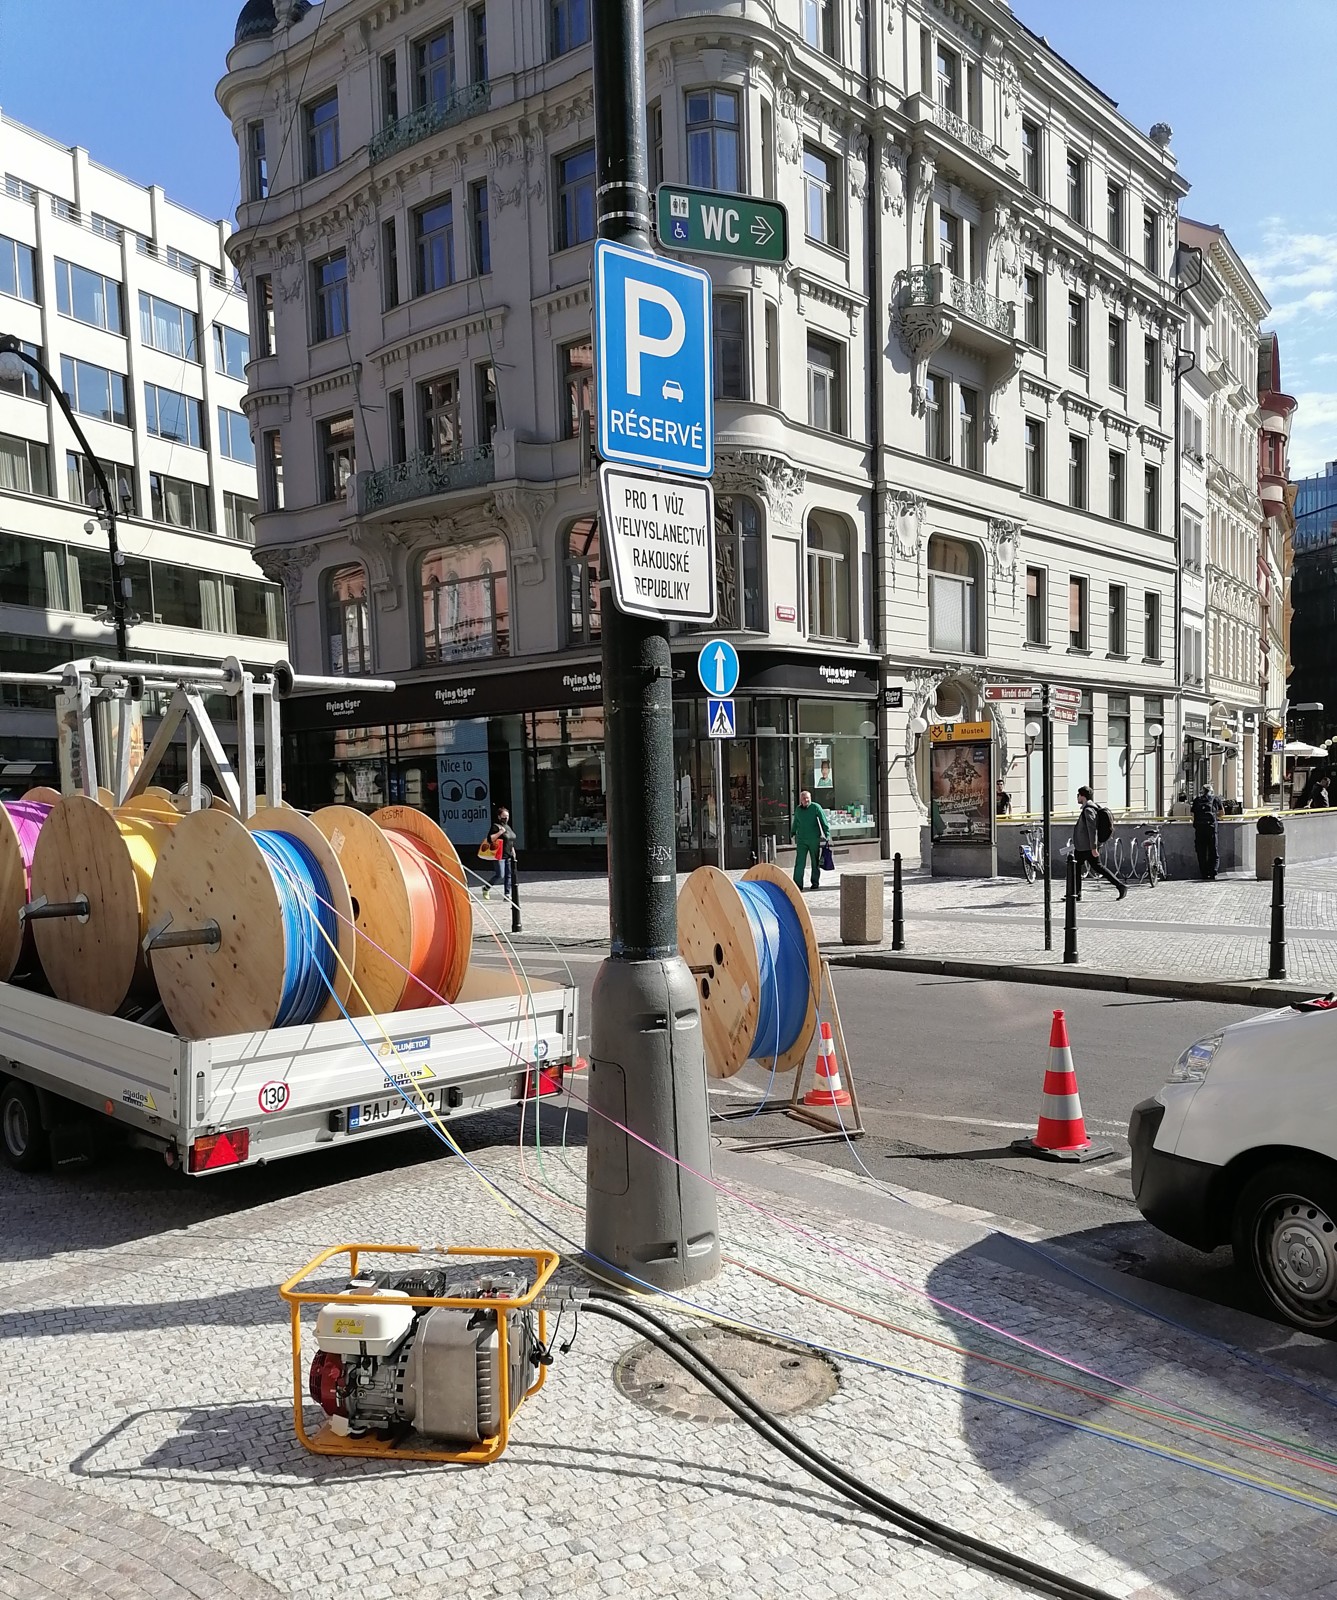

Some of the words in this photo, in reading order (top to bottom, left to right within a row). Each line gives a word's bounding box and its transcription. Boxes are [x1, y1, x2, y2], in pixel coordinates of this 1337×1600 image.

[701, 205, 740, 243] WC
[625, 277, 686, 396] P
[611, 409, 704, 449] RÉSERVÉ
[625, 489, 647, 510] PRO
[652, 494, 659, 511] 1
[664, 492, 685, 516] VŮZ
[615, 516, 706, 547] VELVYSLANECTVÍ
[633, 548, 690, 573] RAKOUSKÉ
[634, 577, 691, 600] REPUBLIKY
[563, 674, 588, 687] flying
[588, 672, 602, 685] tig
[819, 665, 839, 678] flying
[840, 666, 857, 679] tiger
[435, 689, 456, 701] flying
[457, 687, 476, 698] tiger
[326, 701, 344, 712] flying
[344, 699, 361, 710] tiger
[946, 733, 953, 741] B
[440, 759, 461, 773] Nice
[463, 760, 473, 772] to
[442, 809, 460, 823] you
[461, 805, 488, 823] again
[393, 1040, 429, 1052] PLUMETOP
[122, 1088, 149, 1103] agados
[263, 1086, 286, 1106] 130
[363, 1101, 390, 1122] 5AJ
